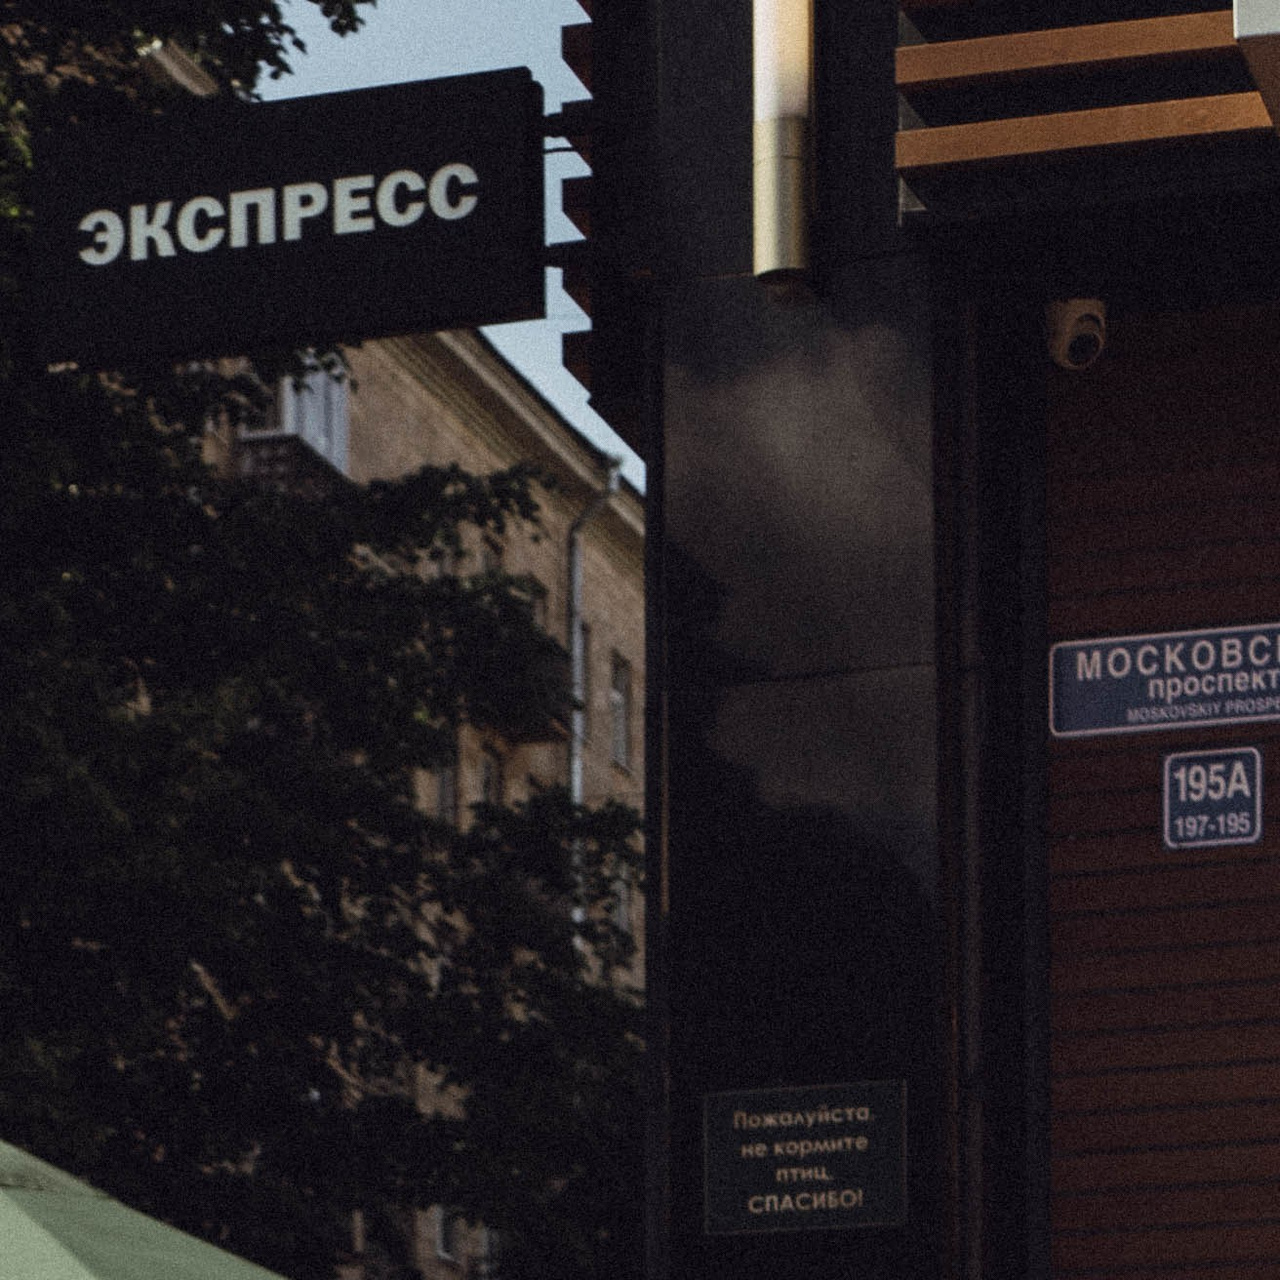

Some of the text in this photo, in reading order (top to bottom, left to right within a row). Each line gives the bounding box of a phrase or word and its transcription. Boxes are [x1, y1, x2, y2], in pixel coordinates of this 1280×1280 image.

[77, 163, 479, 266] ЭКСПРЕСС
[1076, 634, 1280, 682] МОСКОВС
[1148, 668, 1280, 704] проспект
[1175, 812, 1251, 838] 197-195
[740, 1135, 869, 1159] не кормите
[747, 1188, 864, 1214] СПАСИБО!
